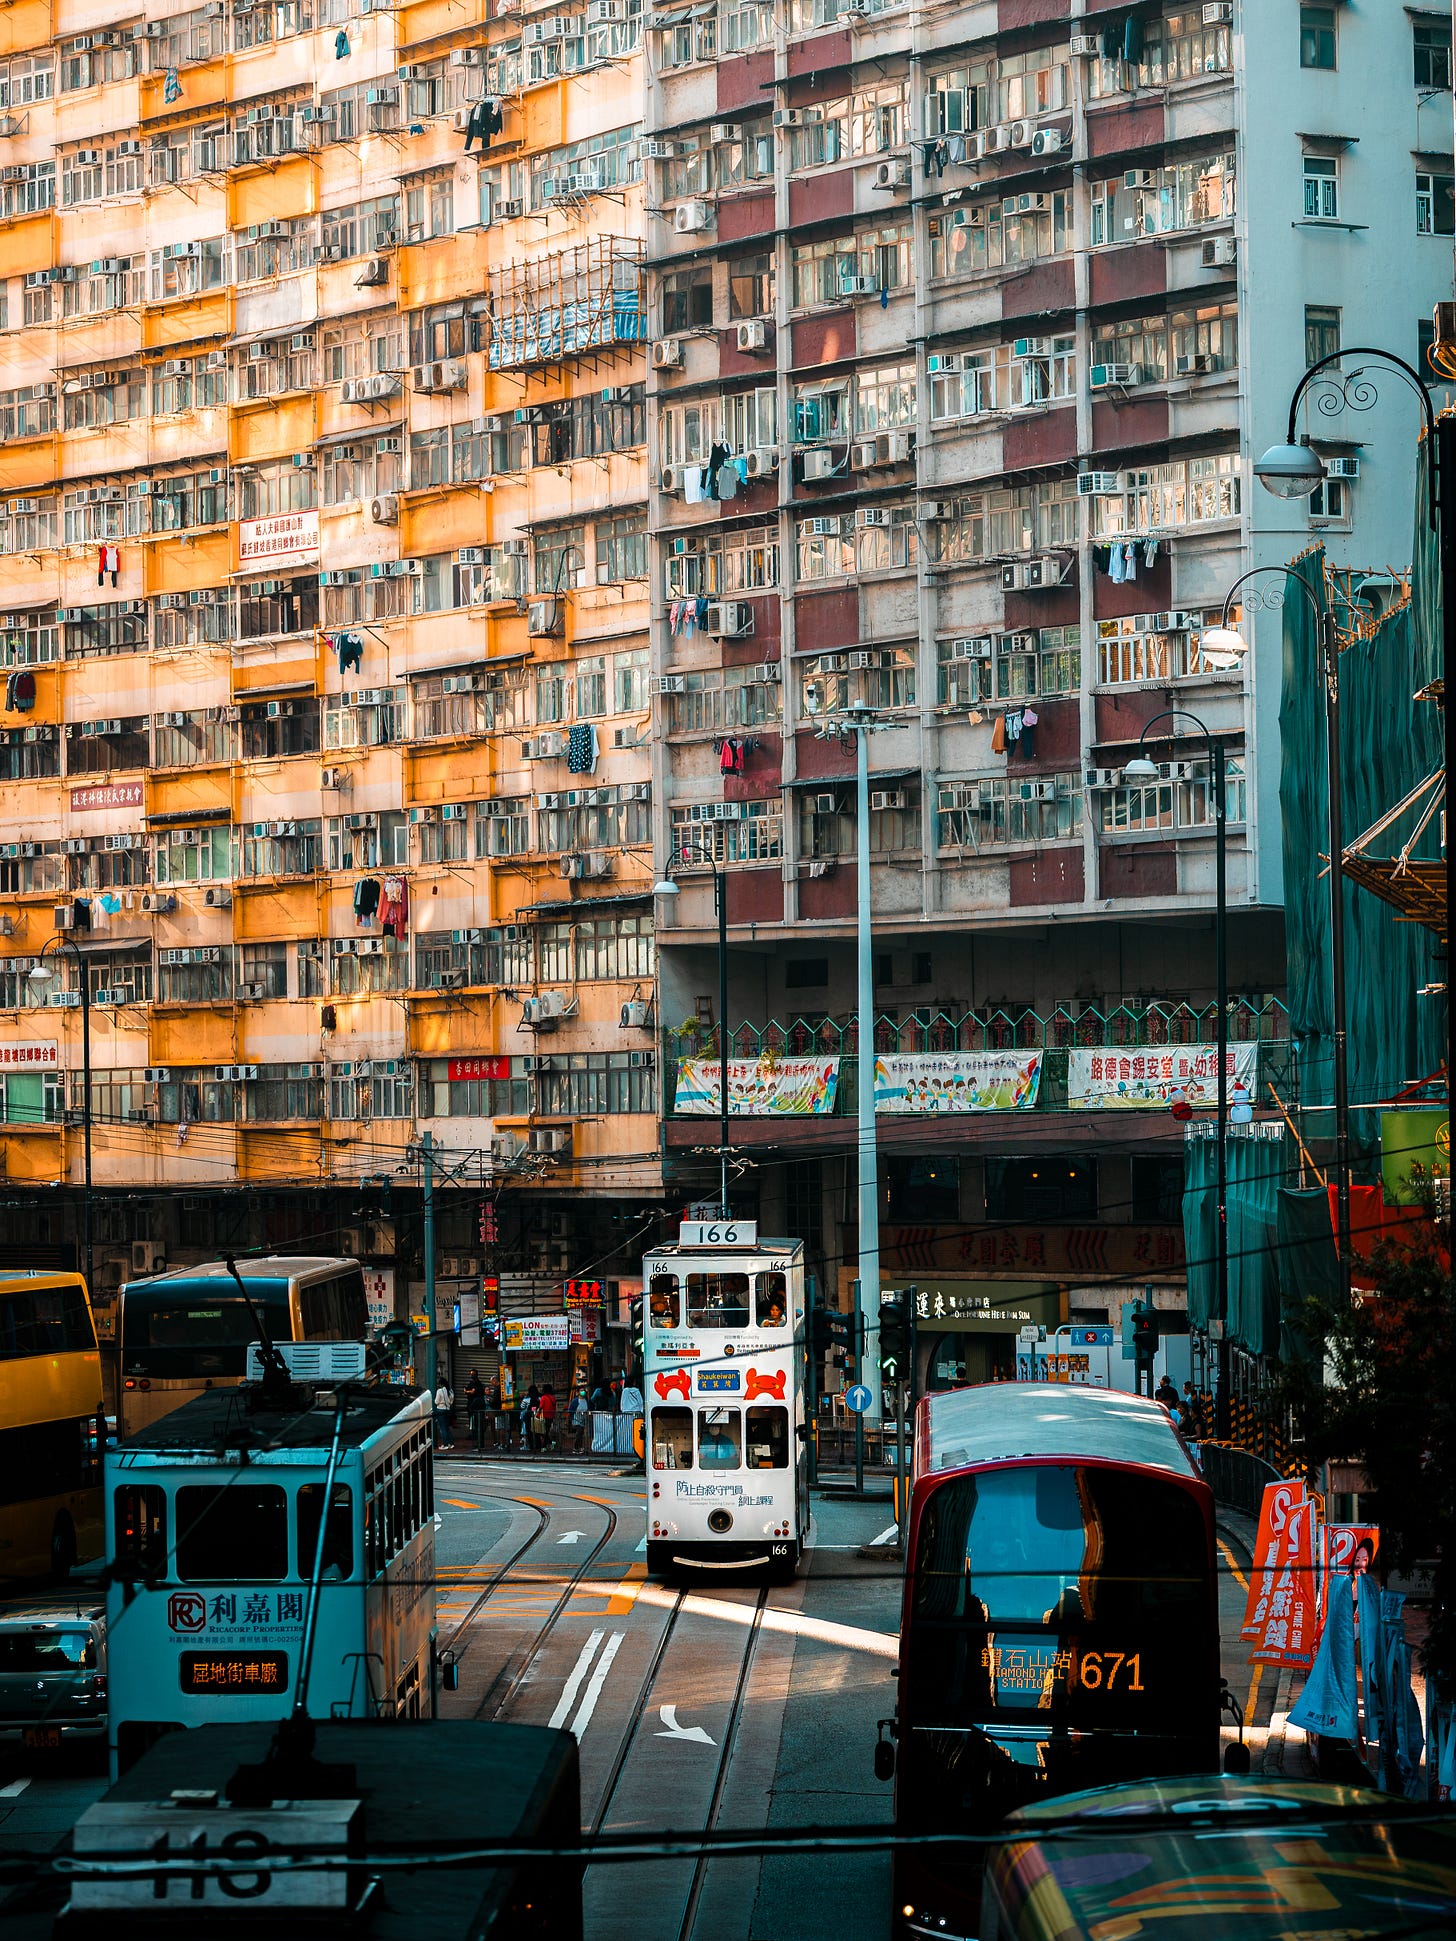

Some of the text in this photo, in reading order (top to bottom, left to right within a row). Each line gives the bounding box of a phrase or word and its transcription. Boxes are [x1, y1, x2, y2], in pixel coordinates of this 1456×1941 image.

[699, 1224, 738, 1243] 166
[652, 1262, 668, 1273] 166
[770, 1261, 786, 1271] 166
[676, 1480, 744, 1497] 防止自殺守門員
[738, 1495, 774, 1507] 網上課程
[772, 1545, 787, 1555] 166
[208, 1592, 304, 1625] 利嘉閣
[192, 1662, 278, 1684] 屈地街車廠
[1081, 1652, 1145, 1691] 671
[1002, 1678, 1047, 1689] STATIO
[153, 1829, 272, 1900] 118
